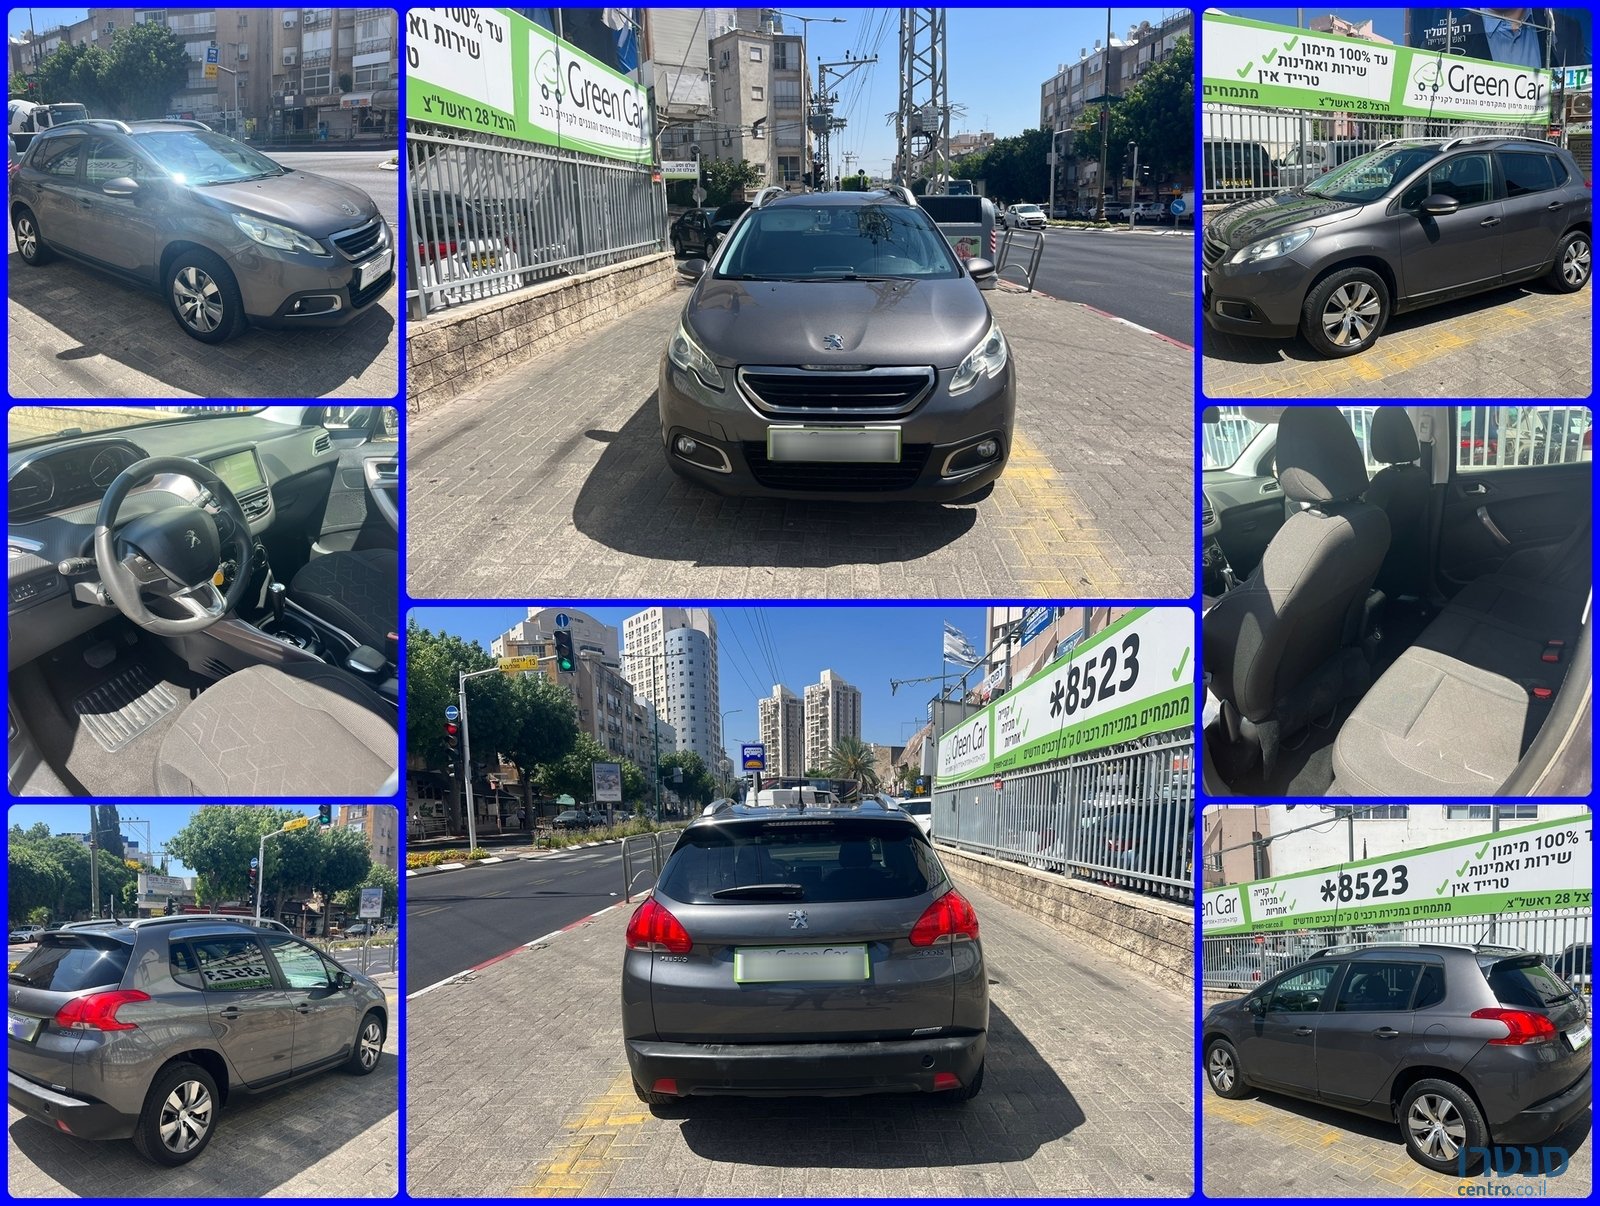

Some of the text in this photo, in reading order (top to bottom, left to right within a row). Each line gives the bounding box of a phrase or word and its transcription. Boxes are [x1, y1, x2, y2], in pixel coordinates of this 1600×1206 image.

[485, 19, 503, 43] עד
[1462, 24, 1472, 33] רז
[434, 23, 480, 60] שירות
[1452, 35, 1466, 43] ראש
[1302, 42, 1388, 65] עד 100% מימון
[1277, 55, 1367, 77] שירות ואמינות
[1258, 69, 1320, 86] טרייד אין
[1448, 65, 1544, 101] Green Car
[568, 61, 643, 130] Green Car
[1203, 84, 1259, 99] מתמחים
[540, 104, 553, 118] רכב
[1356, 100, 1368, 109] 28
[1369, 101, 1390, 111] הרצל
[475, 107, 490, 126] 28
[490, 110, 516, 132] הרצל
[1140, 696, 1190, 726] מתמחים
[1101, 713, 1138, 738] במכירת
[972, 722, 987, 750] Car
[1083, 726, 1100, 743] רכבי
[1023, 744, 1041, 759] חדשים
[1535, 830, 1579, 850] 100%
[1493, 840, 1529, 860] מימון
[1469, 851, 1572, 877] שירות ואמינות
[1254, 887, 1270, 897] קנייה
[1452, 877, 1509, 897] טרייד אין
[1215, 894, 1237, 915] Car
[1260, 896, 1278, 906] מכירה
[1555, 893, 1570, 904] 28
[1574, 892, 1592, 902] צל
[1265, 906, 1287, 916] אחריות
[1360, 910, 1377, 920] רכבי
[1379, 907, 1411, 918] במכירת
[1413, 902, 1451, 915] מתמחים
[1252, 921, 1283, 930] green-car.co.il
[1293, 915, 1314, 925] חדשים
